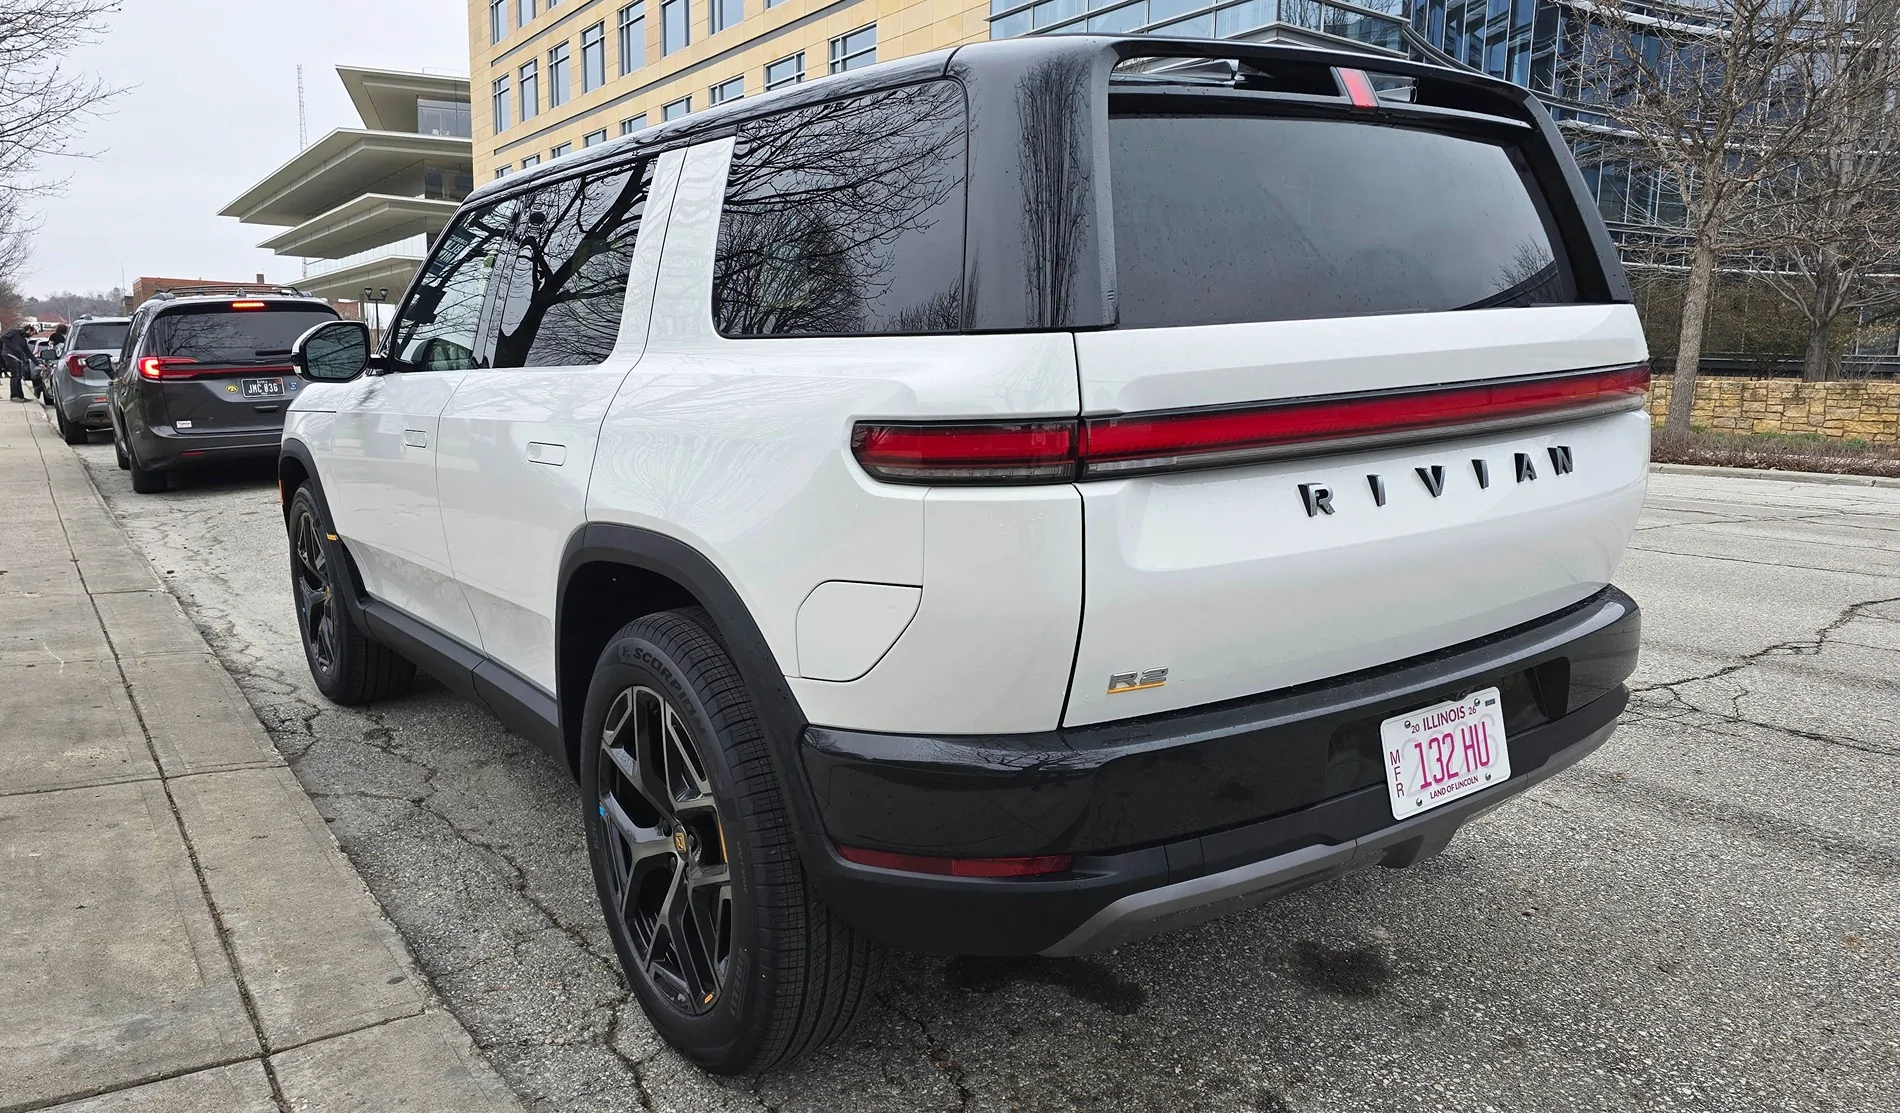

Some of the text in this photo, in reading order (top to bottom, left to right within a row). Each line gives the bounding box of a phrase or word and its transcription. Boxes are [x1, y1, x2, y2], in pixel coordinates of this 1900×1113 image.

[248, 383, 262, 394] JMC
[1297, 446, 1573, 517] RIVIAN
[1108, 666, 1168, 690] R2
[1411, 705, 1477, 734] 20 ILLINOIS 26
[1414, 721, 1490, 790] 132 HU
[1430, 775, 1479, 799] LAND OF LINCOLN
